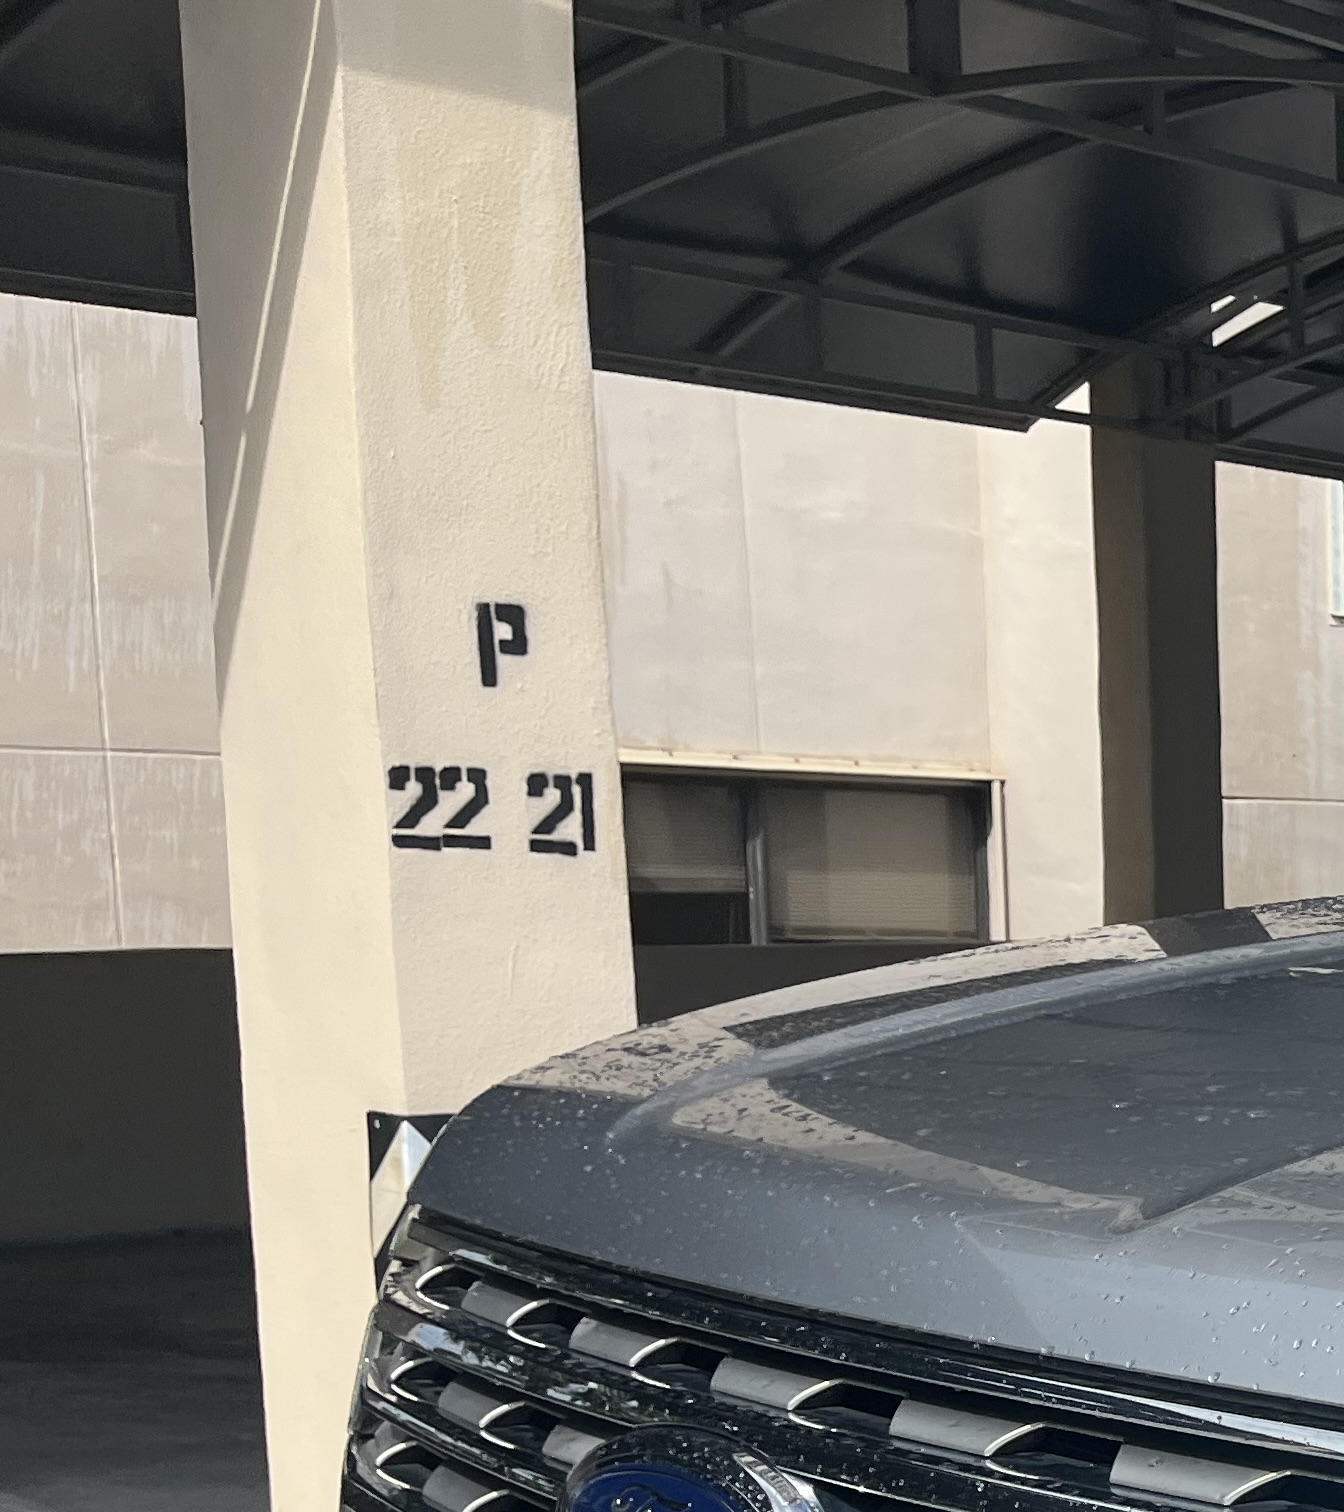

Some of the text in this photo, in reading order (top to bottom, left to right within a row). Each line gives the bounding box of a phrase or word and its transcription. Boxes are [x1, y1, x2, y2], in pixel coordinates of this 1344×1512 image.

[476, 602, 528, 687] P
[388, 765, 596, 857] 22 21
